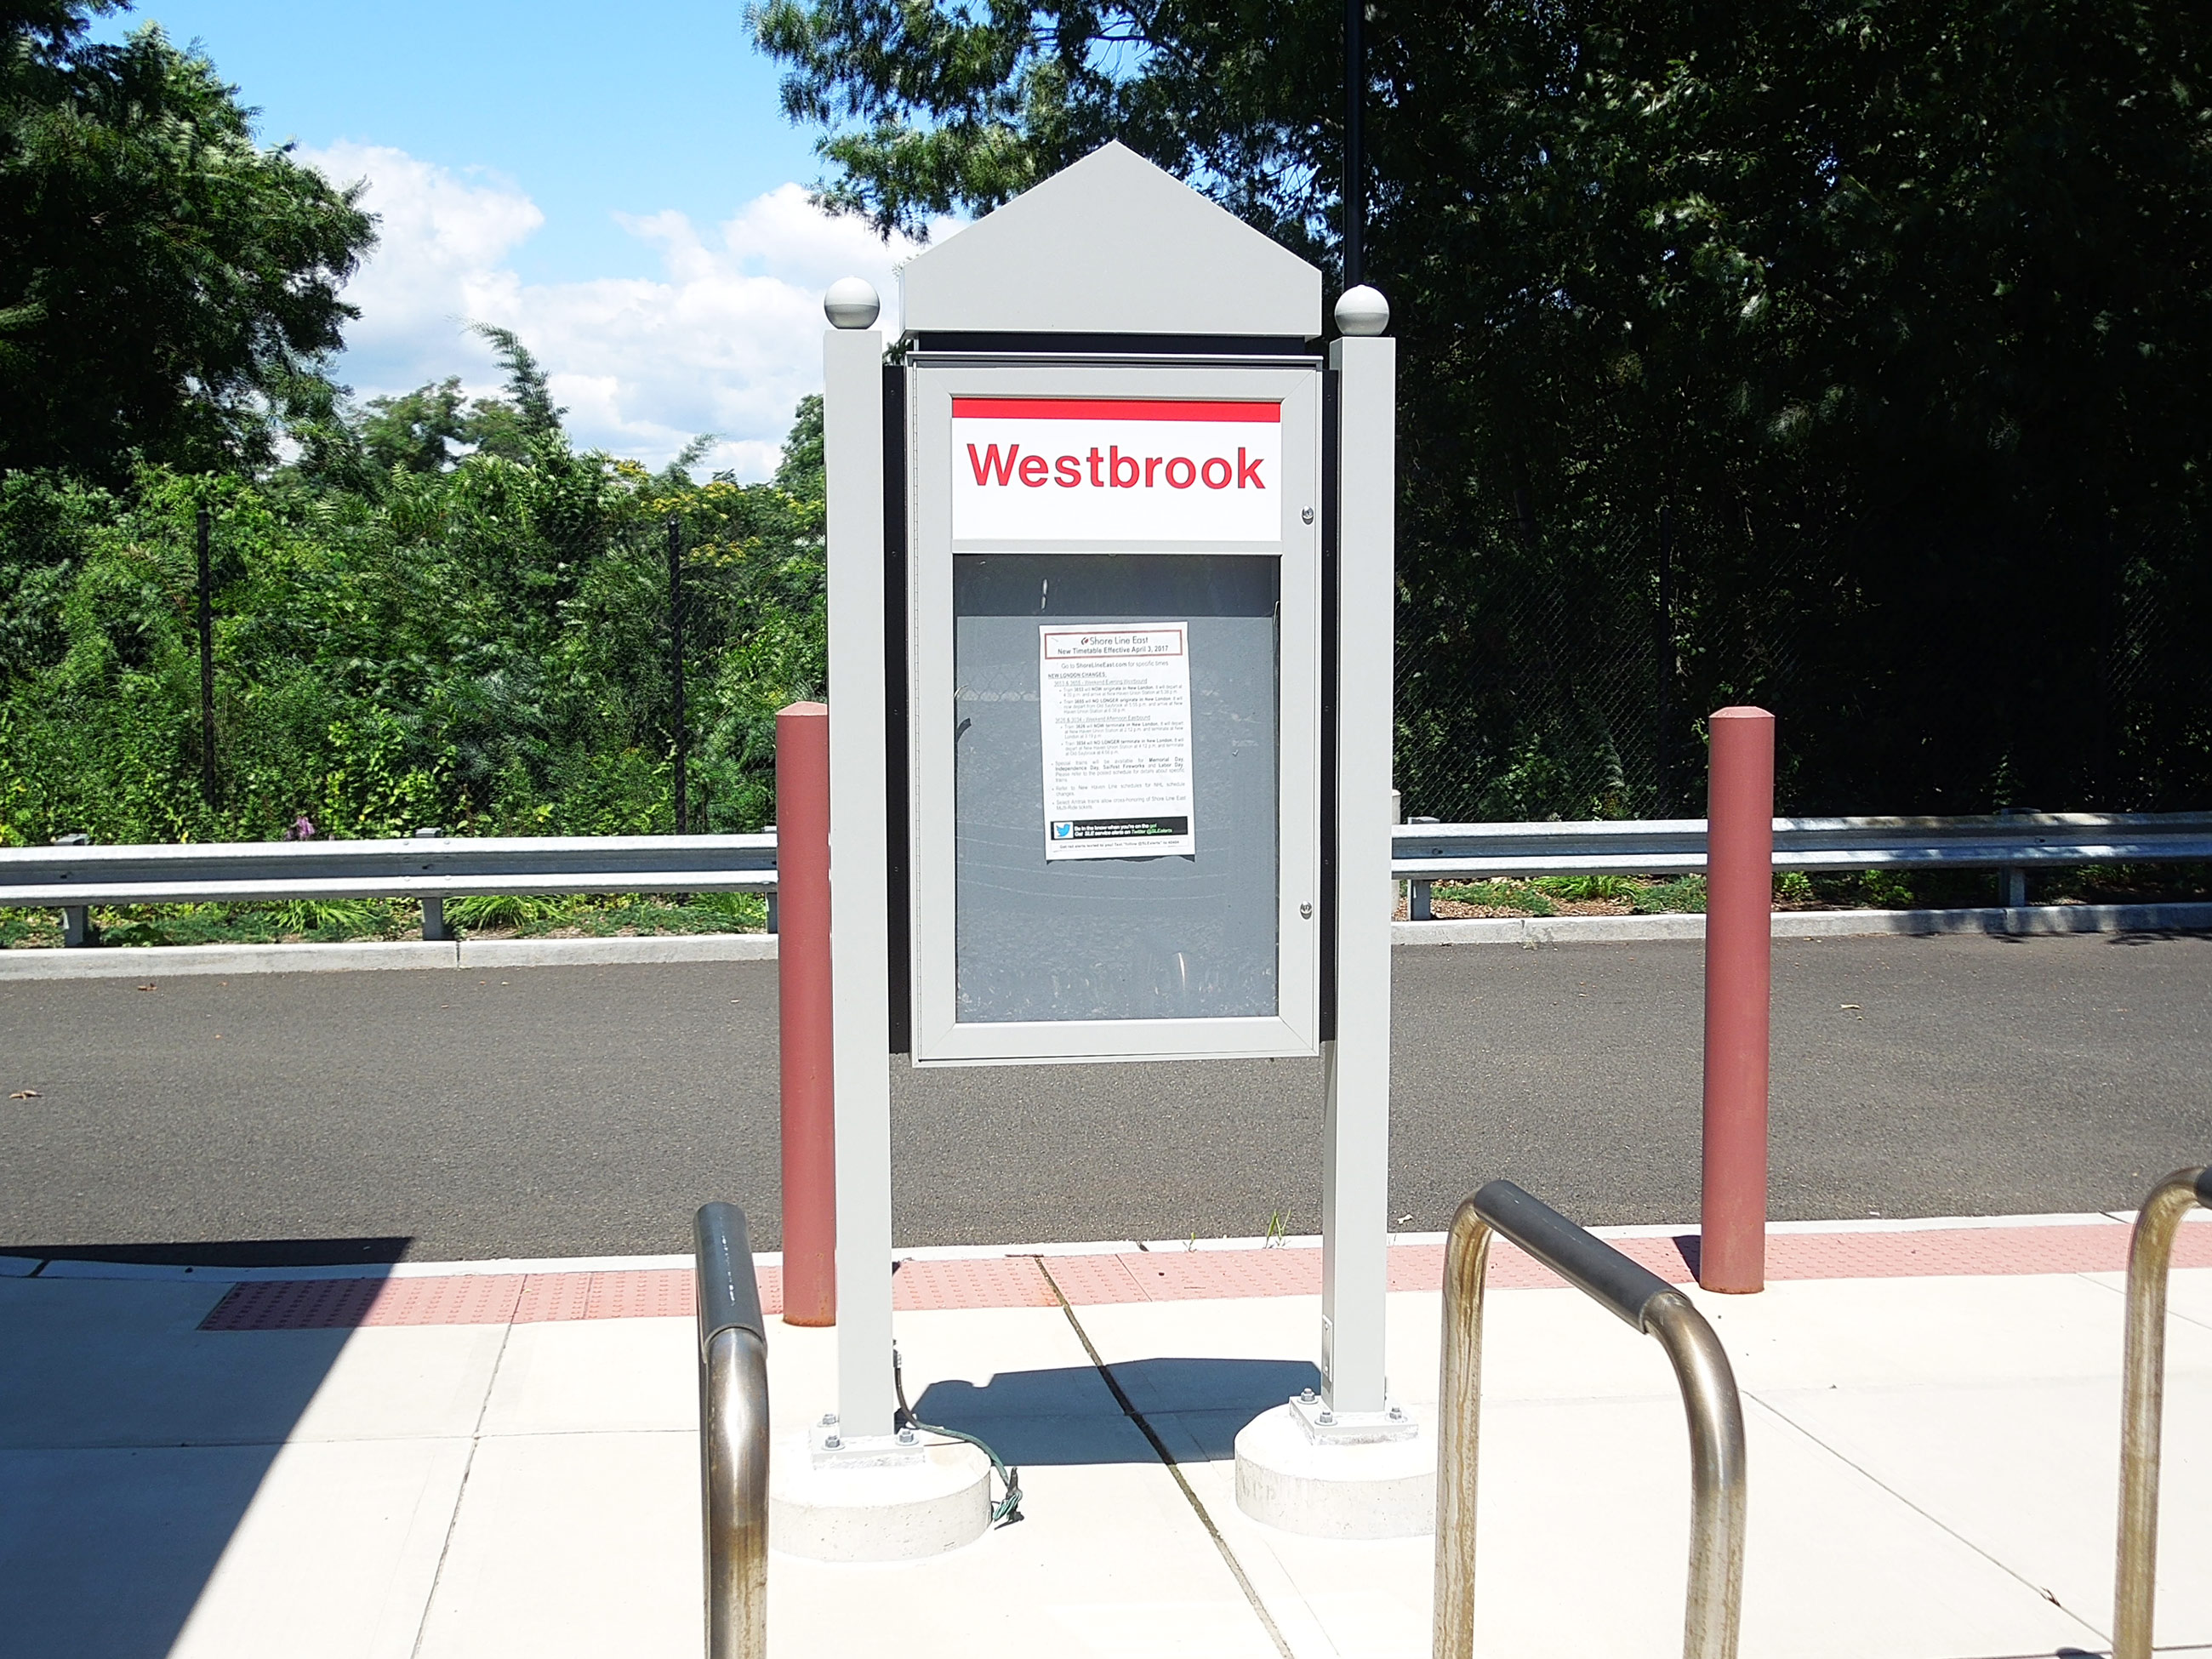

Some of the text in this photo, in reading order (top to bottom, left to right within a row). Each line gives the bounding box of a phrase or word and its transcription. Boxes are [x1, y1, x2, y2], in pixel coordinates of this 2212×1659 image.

[967, 444, 1266, 489] Westbrook
[1089, 636, 1148, 645] Shore Line East
